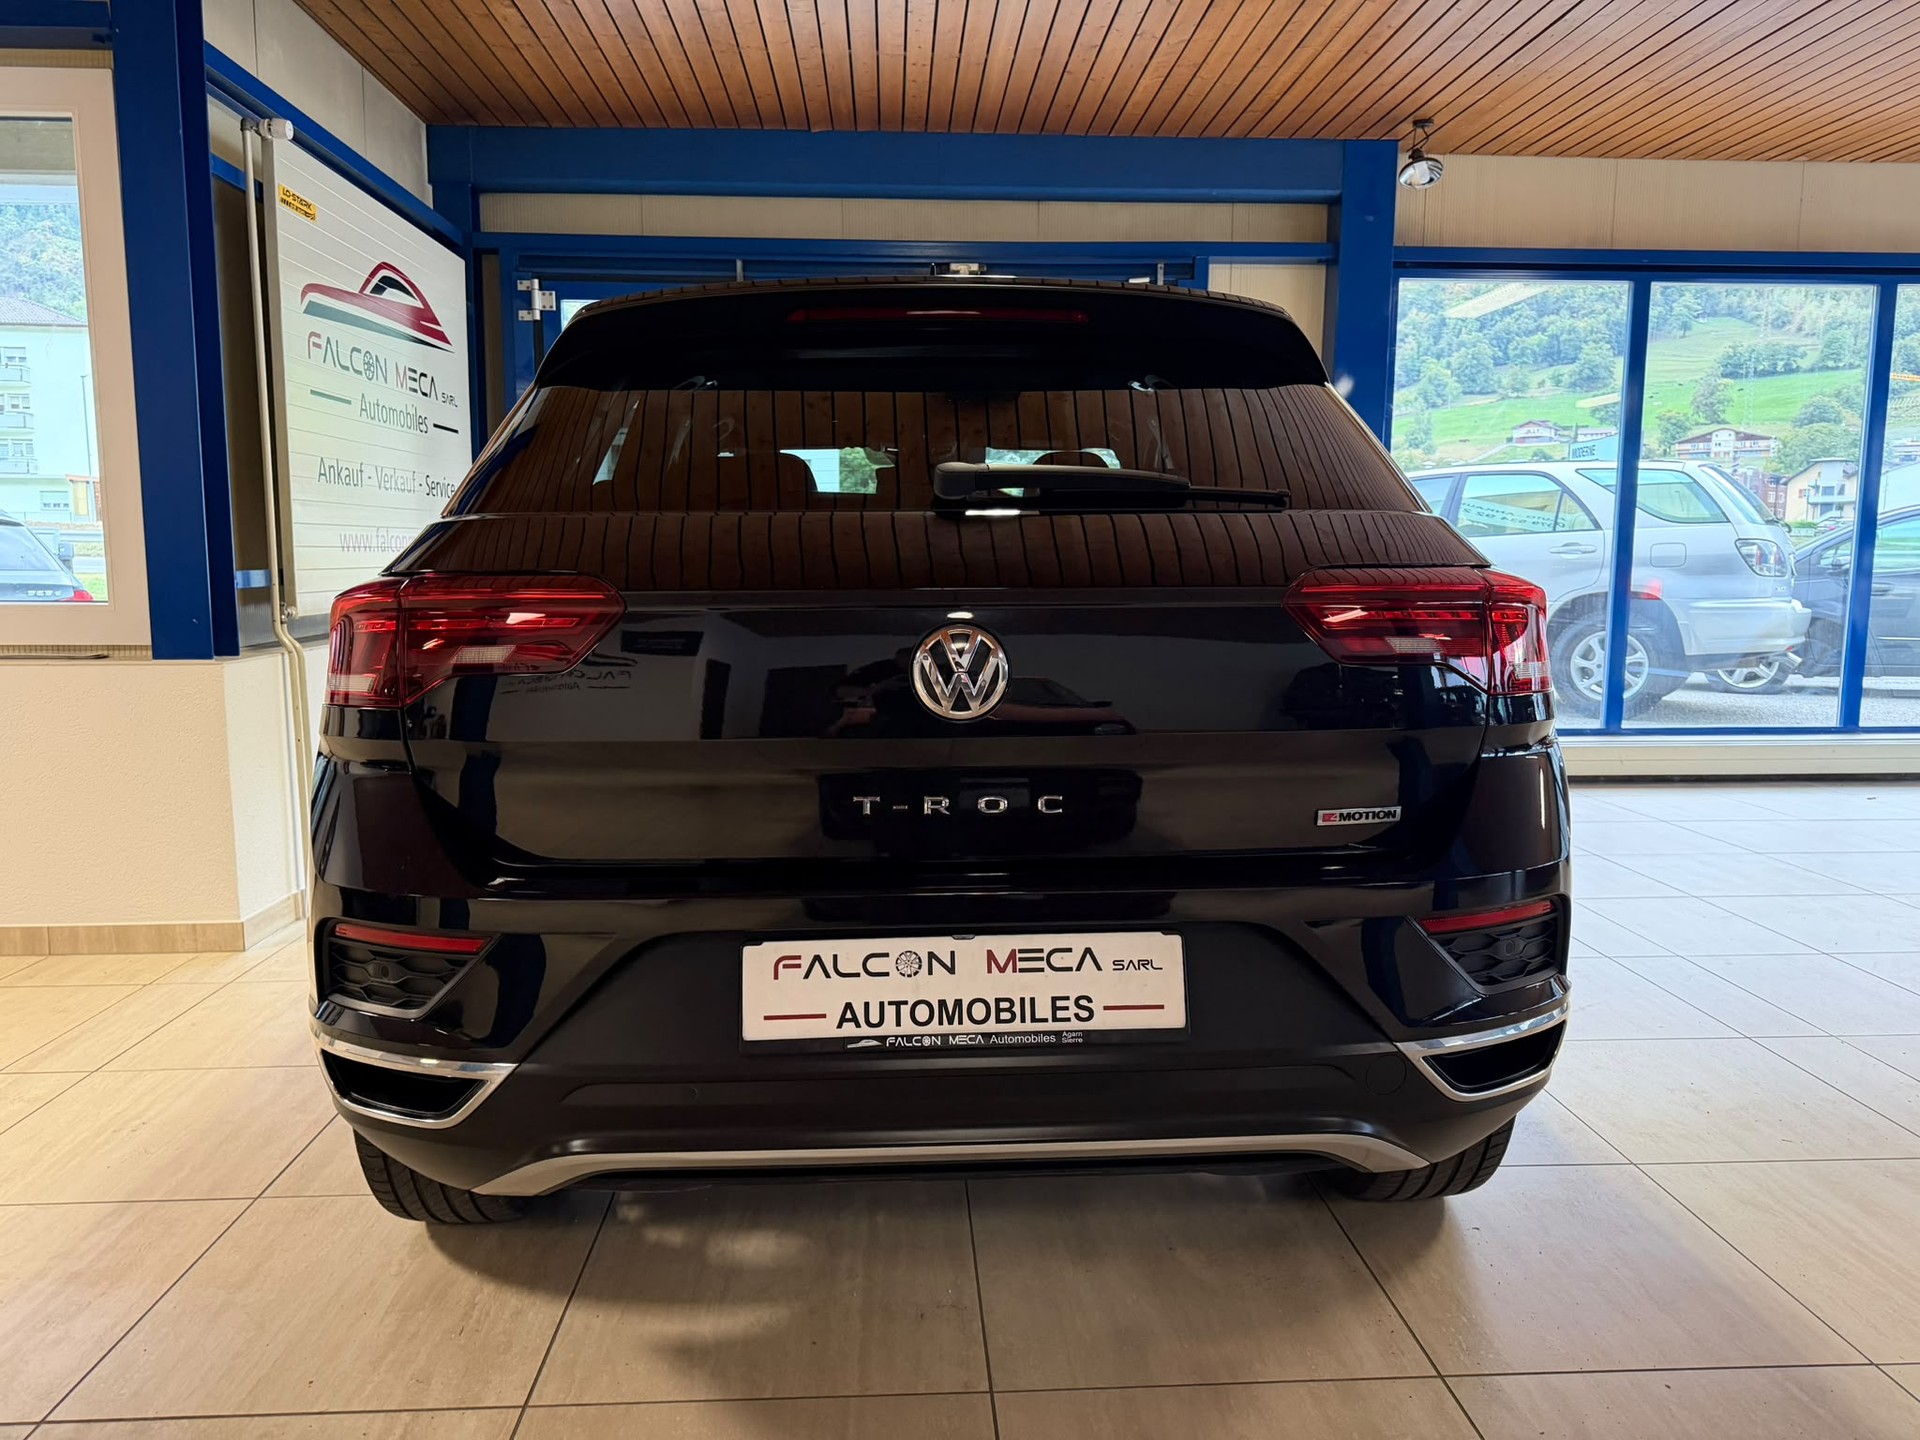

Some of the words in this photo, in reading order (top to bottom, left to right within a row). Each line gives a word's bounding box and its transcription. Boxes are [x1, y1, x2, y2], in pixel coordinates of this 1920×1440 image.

[308, 331, 388, 384] FALCON
[395, 361, 438, 401] MECA
[360, 393, 429, 434] Automobiles
[317, 457, 364, 488] Ankauf
[375, 465, 416, 494] Verkauf
[425, 474, 456, 499] Service
[339, 526, 416, 553] www.falcon
[773, 950, 956, 980] FALCON
[986, 947, 1103, 974] MECA
[1112, 959, 1163, 971] SARL
[836, 995, 1095, 1029] AUTOMOBILES
[886, 1035, 941, 1047] FALCON
[949, 1034, 984, 1045] MECA
[990, 1033, 1056, 1045] Automobiles
